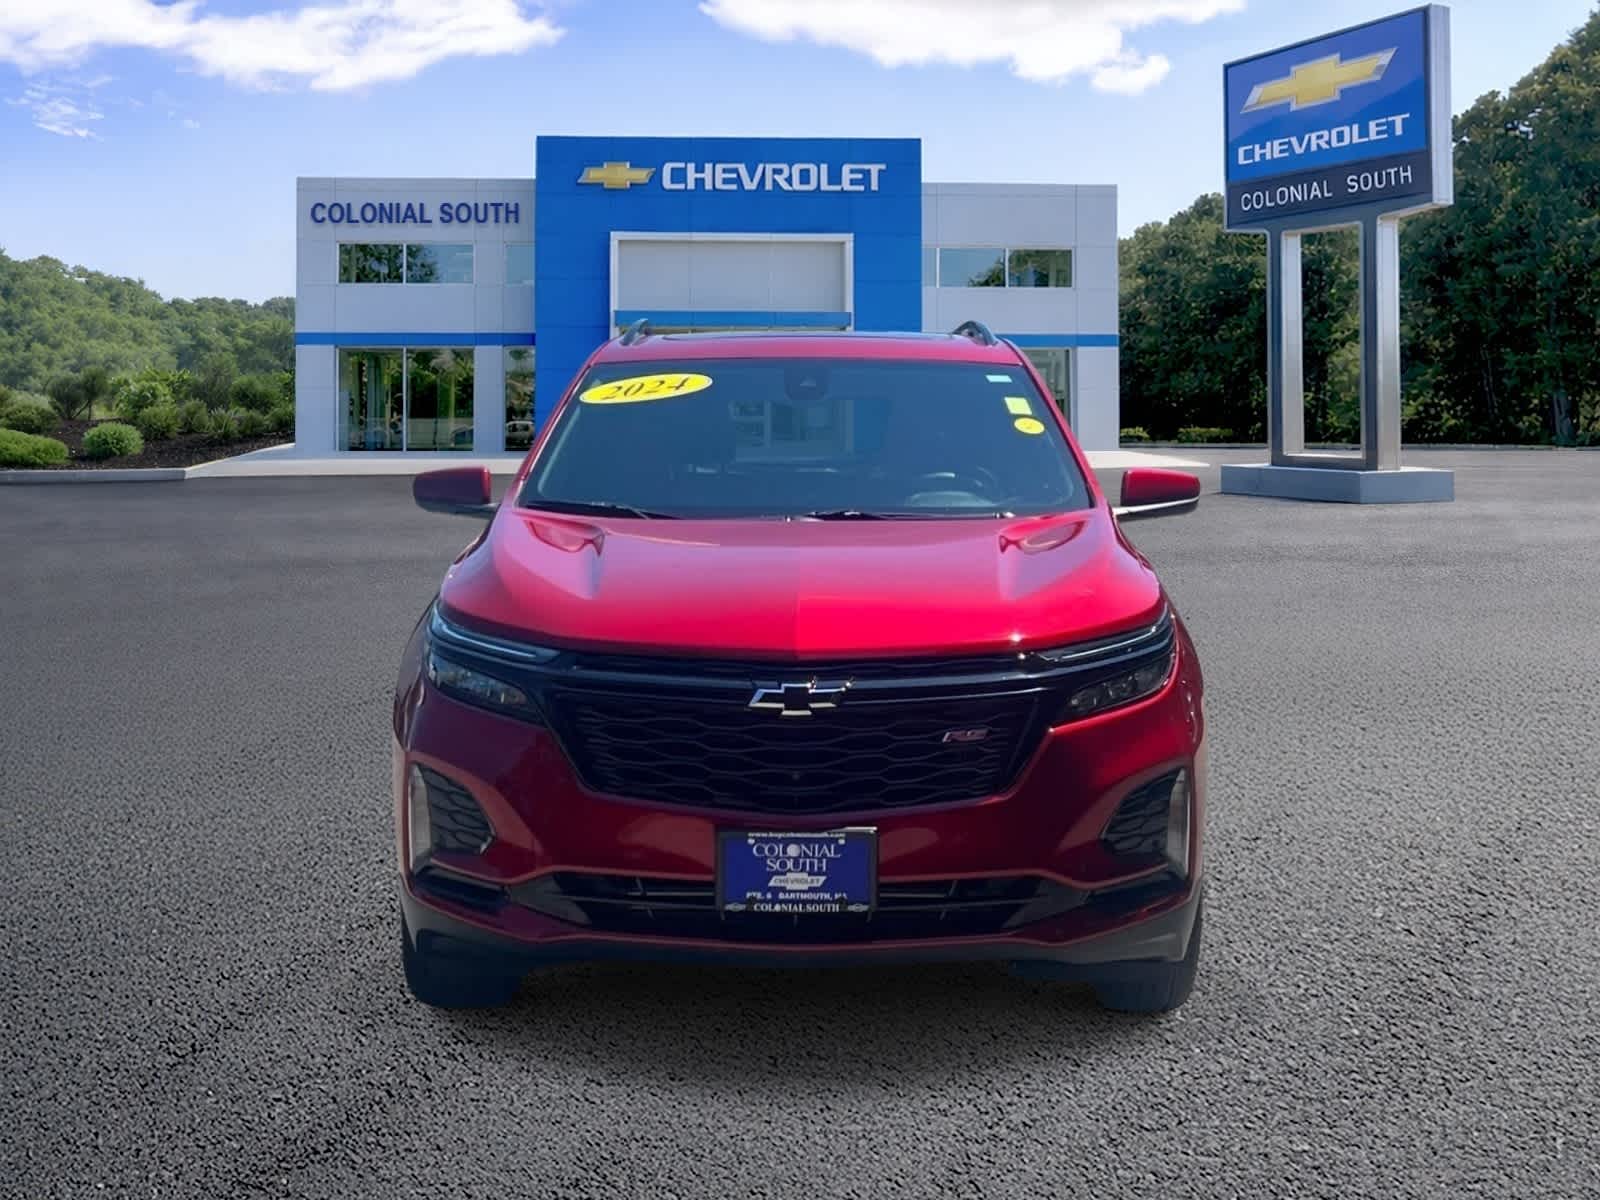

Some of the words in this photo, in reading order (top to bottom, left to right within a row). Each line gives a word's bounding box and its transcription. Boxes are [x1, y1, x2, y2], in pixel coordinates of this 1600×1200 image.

[1238, 113, 1410, 165] CHEVROLET
[661, 162, 887, 192] CHEVROLET
[1241, 180, 1333, 211] COLONIAL
[1347, 165, 1412, 193] SOUTH
[310, 202, 433, 225] COLONIAL
[439, 202, 520, 224] SOUTH
[601, 376, 690, 400] 2024
[752, 843, 841, 858] COLONIAL
[766, 858, 827, 872] SOUTH
